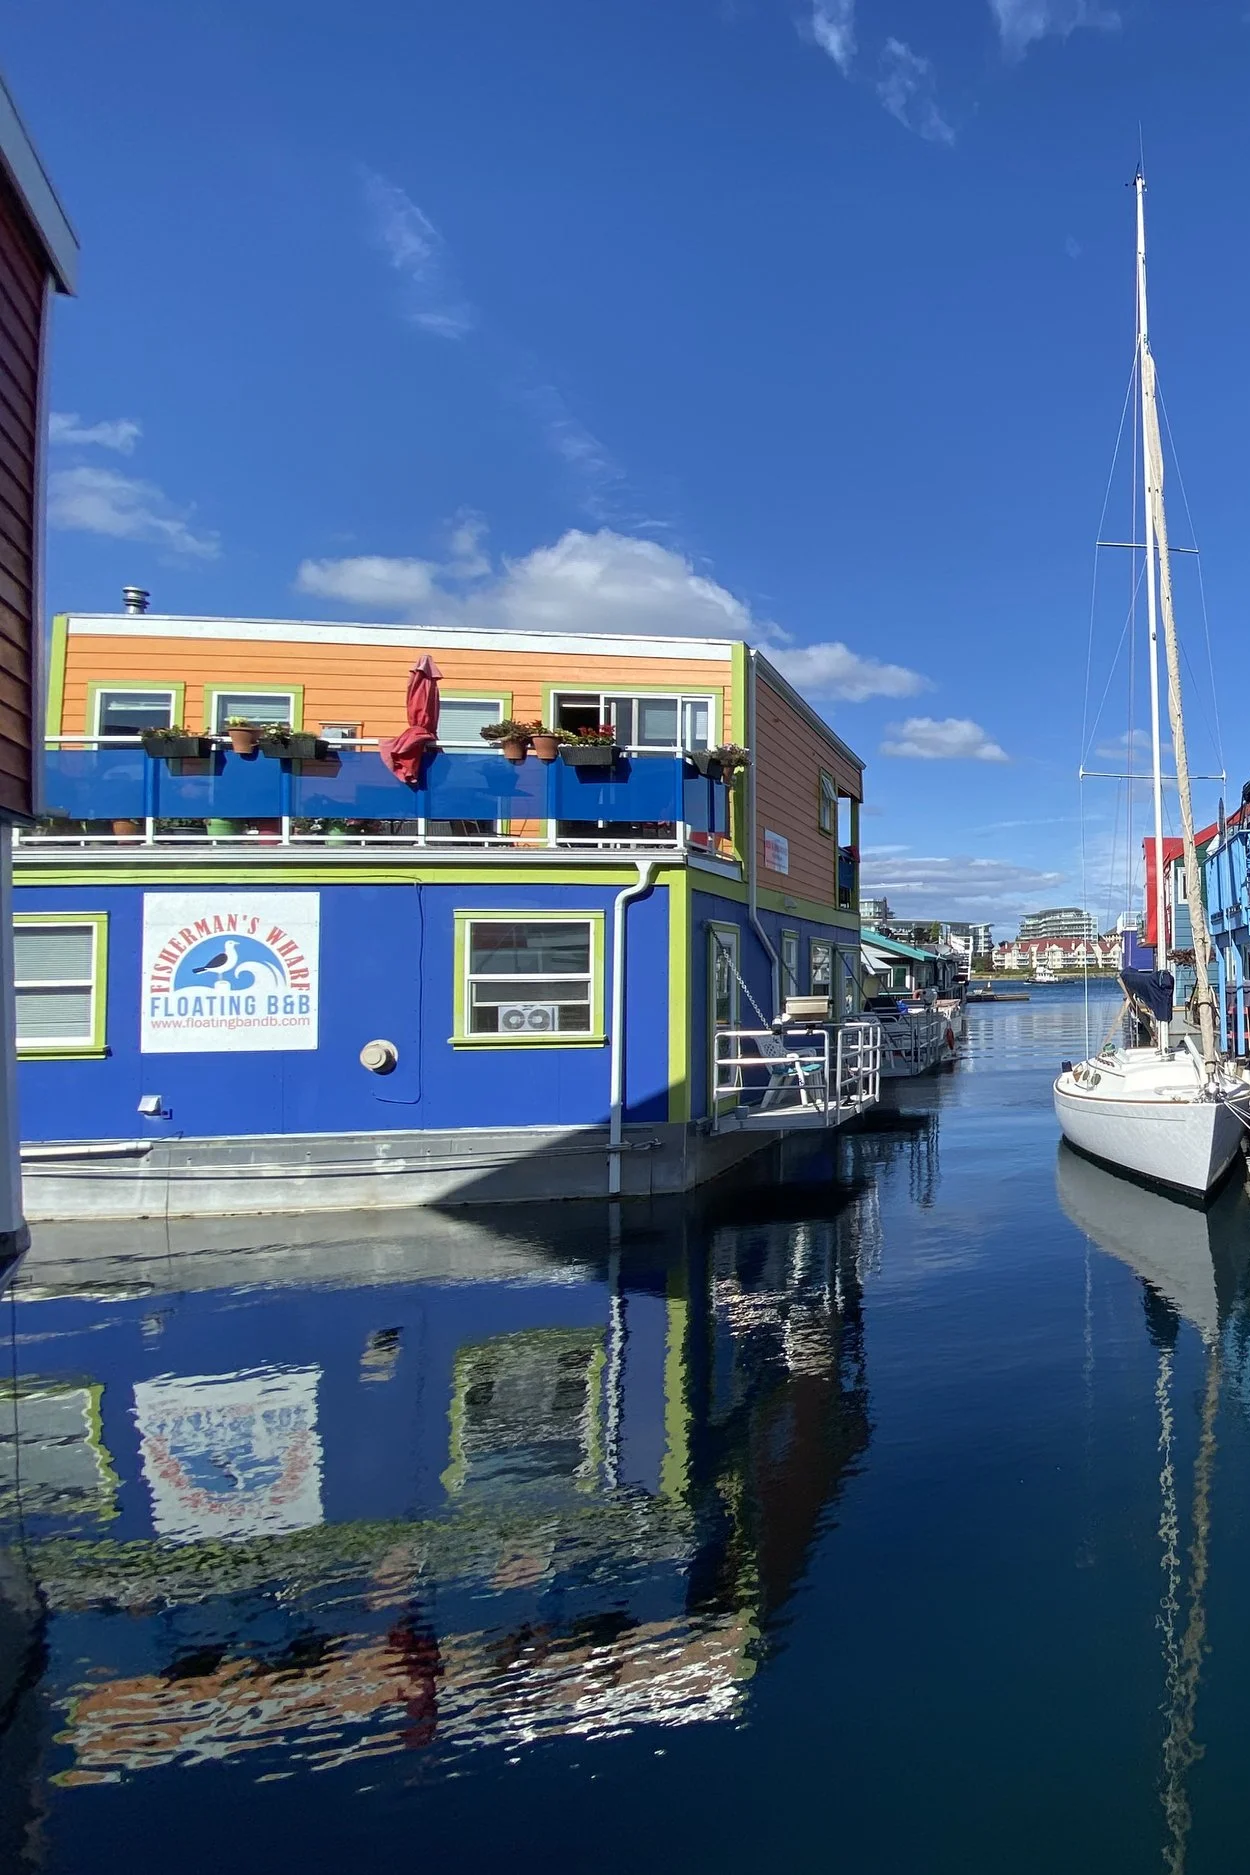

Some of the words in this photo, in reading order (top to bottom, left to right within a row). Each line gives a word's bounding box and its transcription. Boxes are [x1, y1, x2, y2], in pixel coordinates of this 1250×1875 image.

[150, 913, 260, 994] FISHERMAN'S
[265, 925, 311, 992] WHARF
[150, 996, 256, 1017] FLOATING
[267, 995, 311, 1015] B&B
[150, 1016, 311, 1030] www.floatingbandb.com
